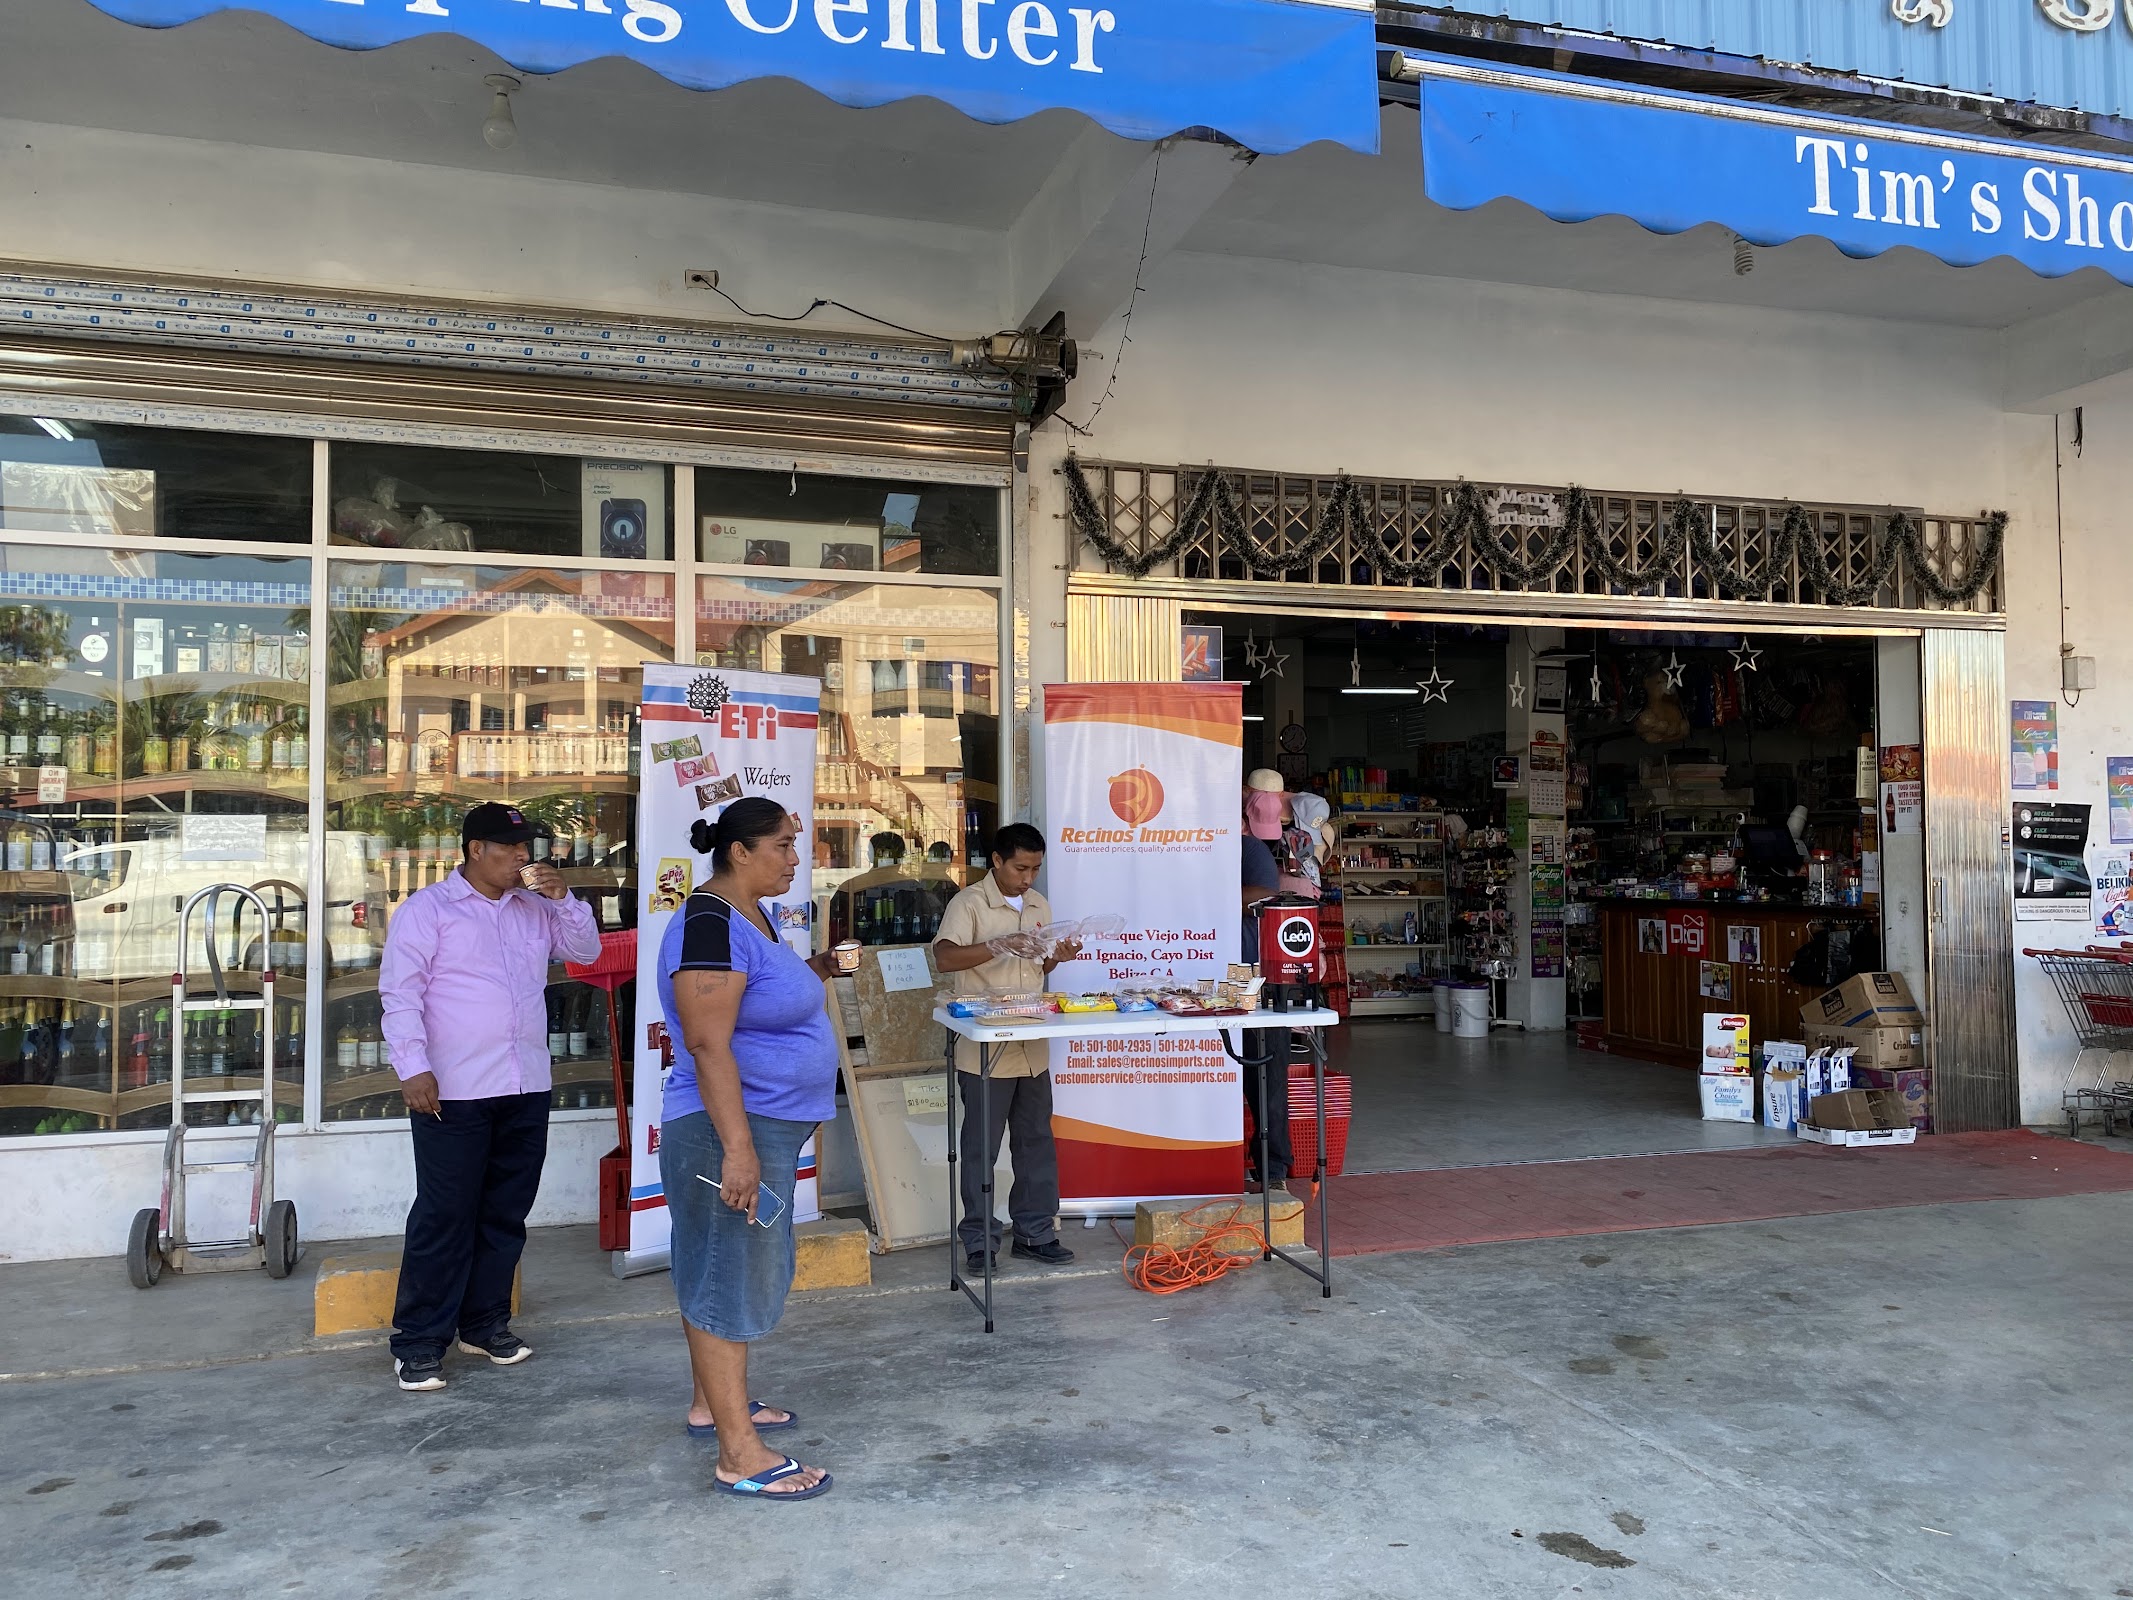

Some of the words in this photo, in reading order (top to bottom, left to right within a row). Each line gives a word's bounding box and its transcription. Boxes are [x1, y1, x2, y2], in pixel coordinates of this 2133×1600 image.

[1795, 135, 2002, 234] Tim's
[587, 462, 643, 471] PRECISION
[1498, 488, 1553, 509] Merry
[723, 526, 737, 534] LG
[743, 767, 791, 789] Wafers
[1060, 827, 1134, 843] Recinos
[1139, 827, 1214, 845] Imports
[1064, 845, 1110, 853] Guaranteed
[1111, 845, 1136, 854] prices,
[1138, 845, 1165, 854] quality
[1145, 929, 1179, 944] Viejo
[1183, 929, 1216, 941] Road
[1283, 930, 1310, 942] León
[1096, 949, 1147, 963] Ignacio,
[1151, 949, 1183, 962] Cayo
[1187, 949, 1214, 960] Dist
[895, 975, 914, 984] each
[1069, 1040, 1085, 1052] Tel:
[1087, 1040, 1151, 1053] 501-804-2935
[1159, 1039, 1222, 1052] 501-824-4066
[1067, 1056, 1095, 1069] Email:
[1096, 1055, 1225, 1069] sales@recinosimports.com
[1055, 1071, 1237, 1085] customerservice@recinosimports.com
